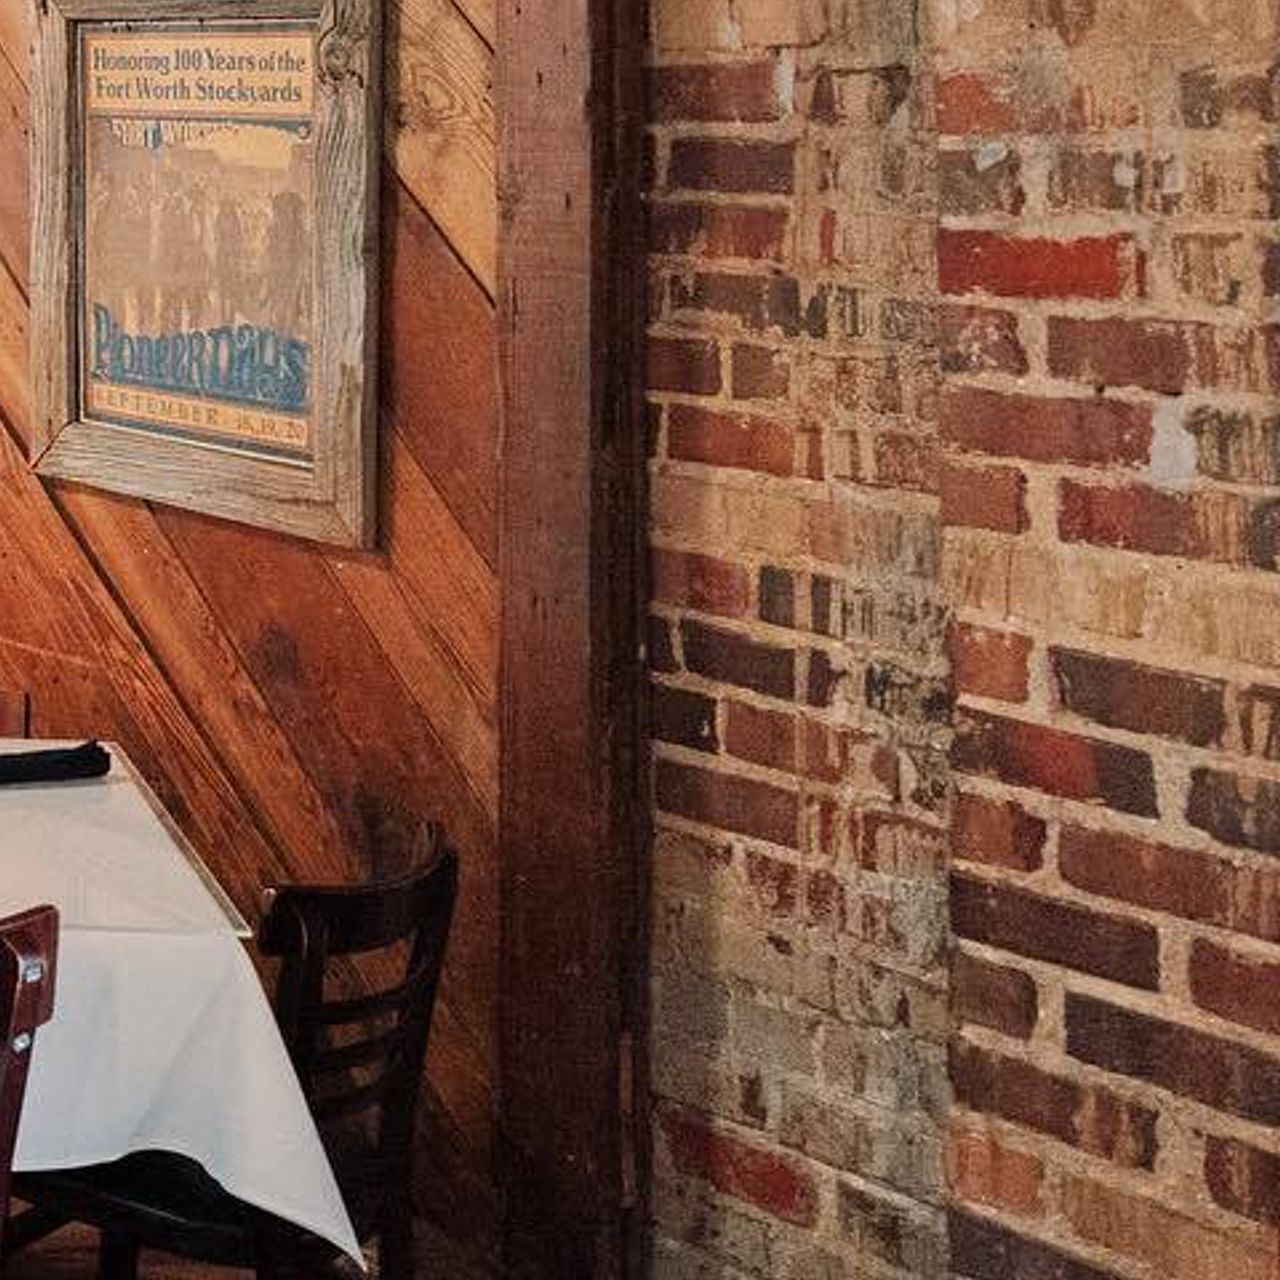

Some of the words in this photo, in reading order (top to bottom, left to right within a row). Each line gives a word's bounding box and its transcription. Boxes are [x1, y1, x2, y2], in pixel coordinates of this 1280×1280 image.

[93, 47, 170, 75] Honoring
[175, 47, 202, 71] 100
[203, 47, 254, 71] Years
[276, 50, 305, 73] the
[95, 76, 132, 99] Fort
[135, 76, 190, 100] Worth
[194, 76, 303, 107] Stockyards
